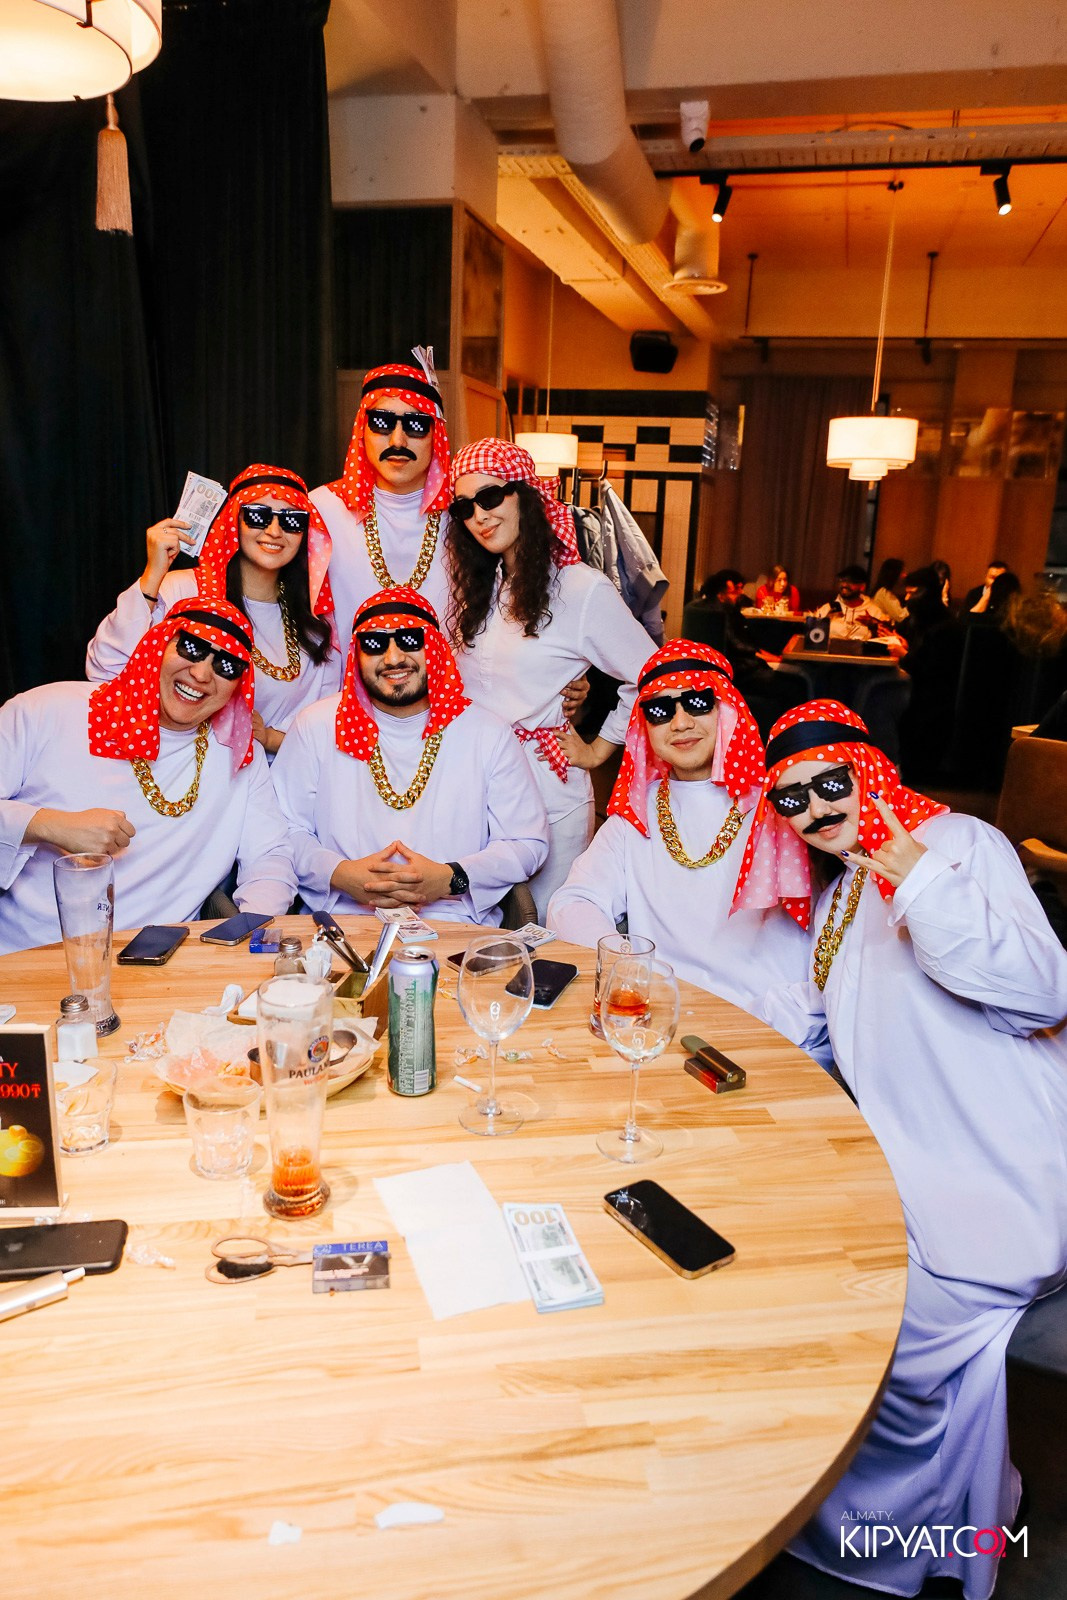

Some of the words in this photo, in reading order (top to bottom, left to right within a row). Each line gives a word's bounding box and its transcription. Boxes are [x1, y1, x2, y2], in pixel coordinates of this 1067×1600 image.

[197, 484, 219, 501] 100
[524, 927, 546, 938] 100
[514, 1209, 557, 1225] 100
[342, 1241, 384, 1252] TEREA
